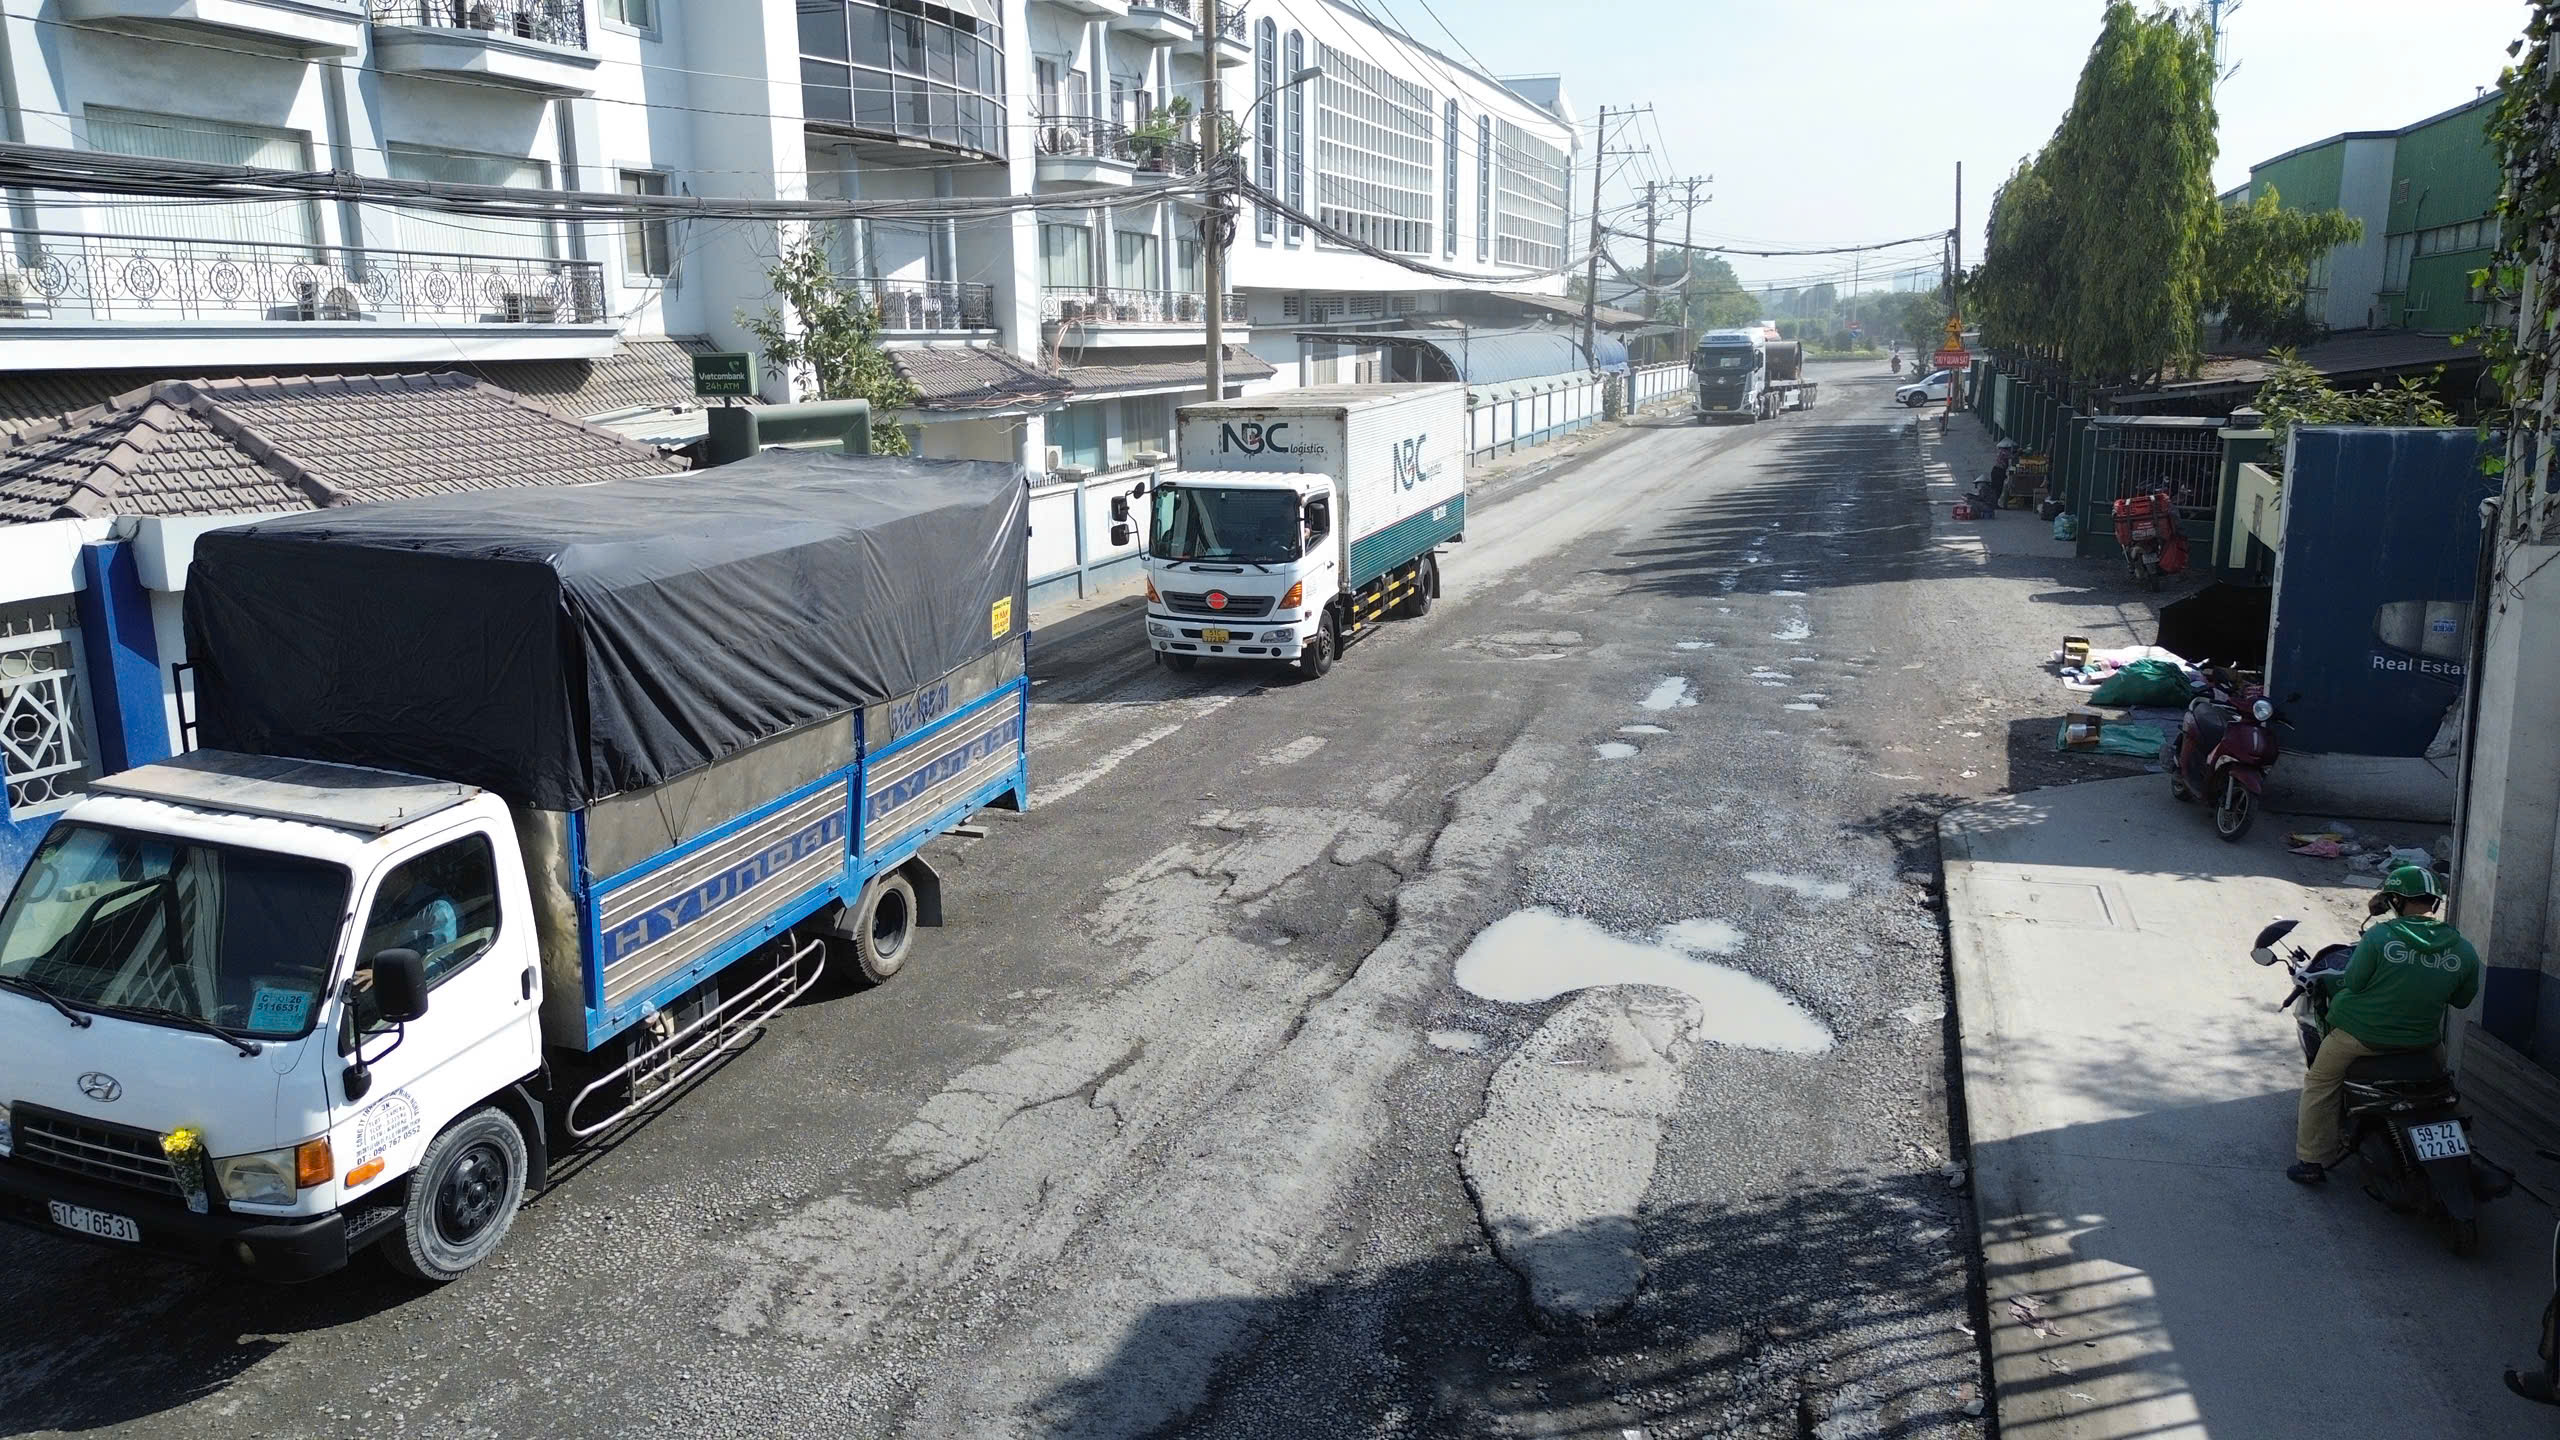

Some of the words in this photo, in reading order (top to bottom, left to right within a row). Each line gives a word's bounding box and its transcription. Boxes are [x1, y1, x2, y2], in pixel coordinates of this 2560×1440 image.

[698, 371, 746, 380] Vietcombank
[705, 381, 722, 390] 24h
[723, 382, 740, 390] ATM
[1222, 422, 1289, 455] NBC
[1290, 443, 1325, 456] logistics
[2373, 656, 2413, 671] Real
[615, 819, 839, 956] HYUNDAI
[2384, 940, 2461, 972] Grab
[404, 1124, 421, 1140] 0552
[2417, 1124, 2456, 1142] 59-Z2
[2418, 1139, 2466, 1158] 122.84
[51, 1203, 133, 1239] 51C-165.31
